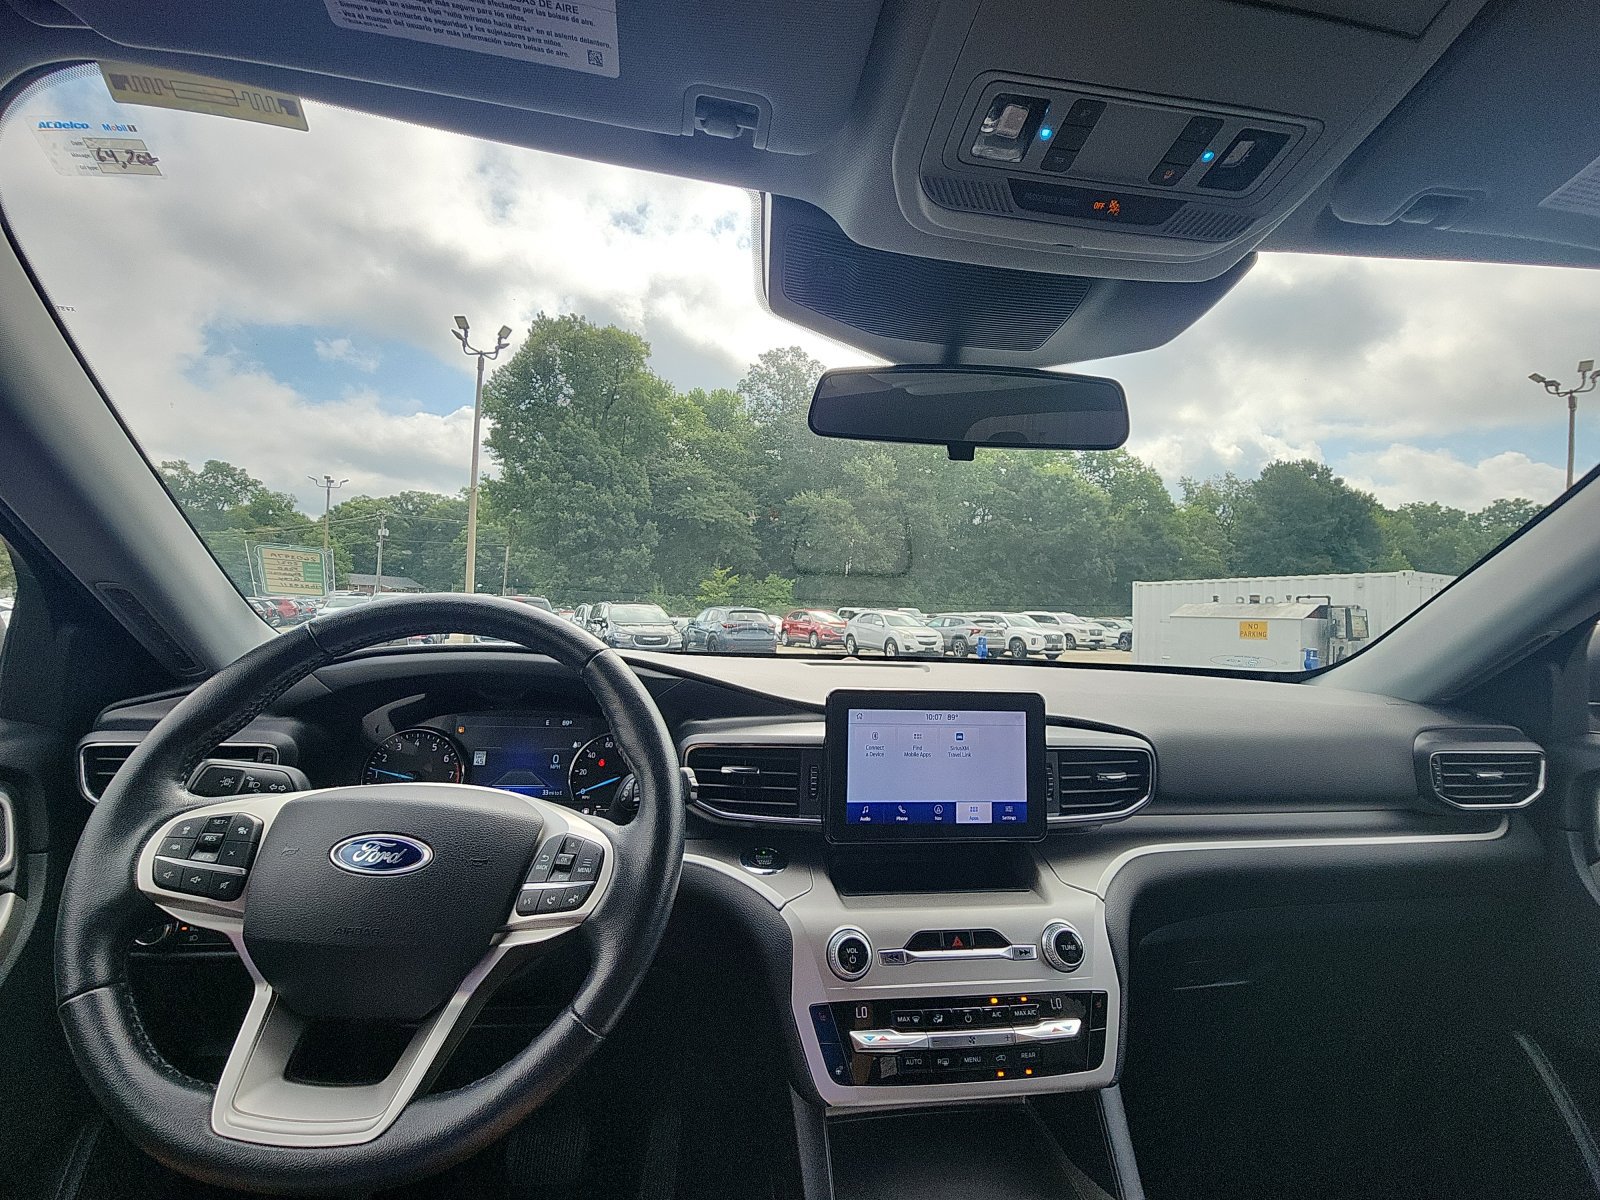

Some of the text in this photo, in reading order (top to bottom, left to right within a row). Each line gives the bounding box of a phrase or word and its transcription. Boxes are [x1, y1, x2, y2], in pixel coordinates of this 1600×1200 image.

[451, 2, 476, 13] seguro
[476, 7, 493, 16] para
[538, 0, 553, 9] DE
[555, 2, 580, 15] AIRE
[547, 11, 570, 22] bolsas
[570, 16, 580, 24] de
[38, 121, 90, 130] ACDelco
[101, 123, 128, 132] Mobil
[1093, 201, 1106, 210] OFF
[1240, 630, 1267, 638] PARKING
[925, 713, 943, 721] 10:07
[396, 742, 403, 751] 3
[414, 738, 421, 748] 4
[431, 743, 439, 752] 5
[604, 741, 614, 749] 60
[865, 744, 885, 752] Connect
[381, 753, 389, 763] 2
[443, 754, 450, 763] 6
[587, 751, 597, 759] 40
[919, 751, 932, 759] Apps
[448, 770, 455, 779] 7
[578, 768, 588, 776] 20
[1001, 814, 1017, 822] Settings
[352, 840, 408, 865] Ford
[1050, 998, 1063, 1010] LO
[855, 1006, 868, 1019] LO
[1027, 1009, 1037, 1017] A/C
[897, 1015, 911, 1023] MAX
[1020, 1051, 1037, 1059] REAR
[905, 1058, 923, 1066] AUTO
[963, 1056, 982, 1064] MENU
